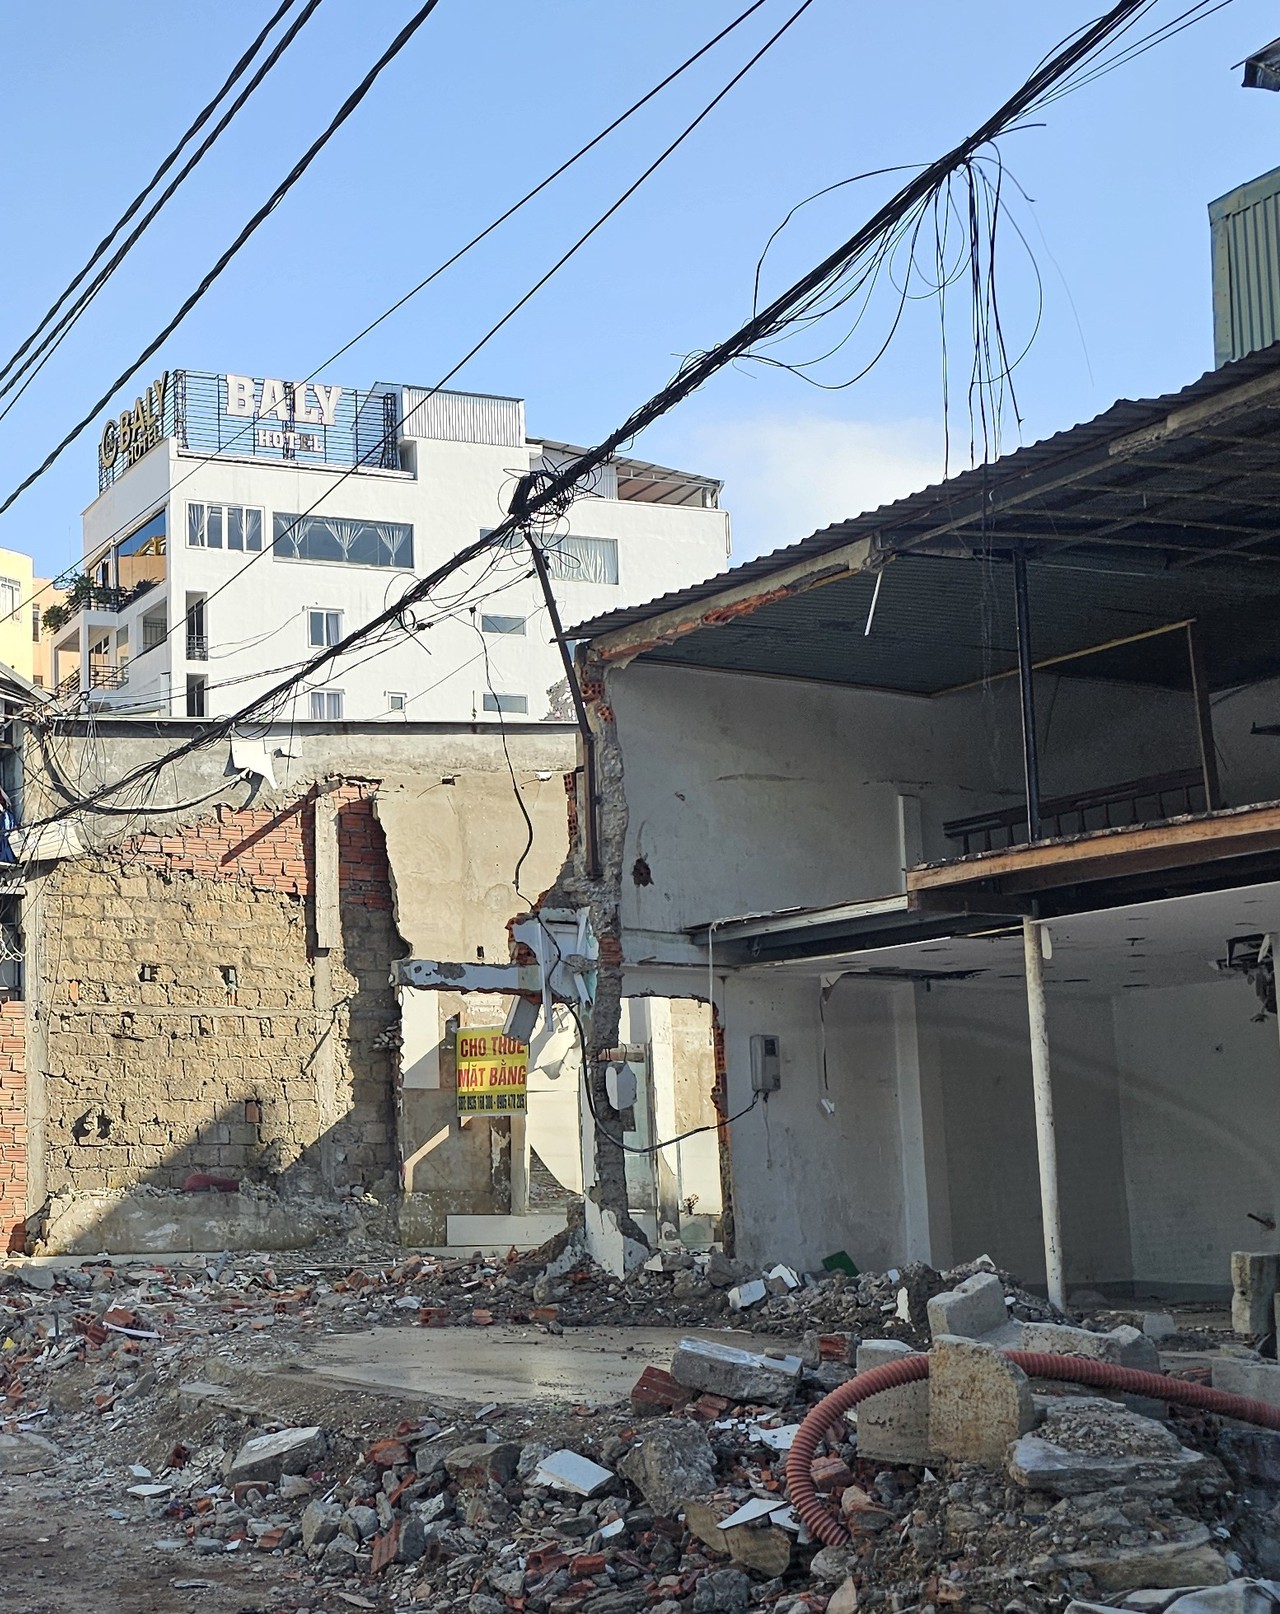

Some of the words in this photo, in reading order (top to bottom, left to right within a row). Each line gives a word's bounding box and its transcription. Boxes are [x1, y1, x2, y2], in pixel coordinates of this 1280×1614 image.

[120, 370, 169, 454] BALY
[226, 374, 342, 426] BALY
[127, 424, 160, 468] HOTEL
[257, 429, 325, 452] HOTEL
[461, 1038, 486, 1057] CHO
